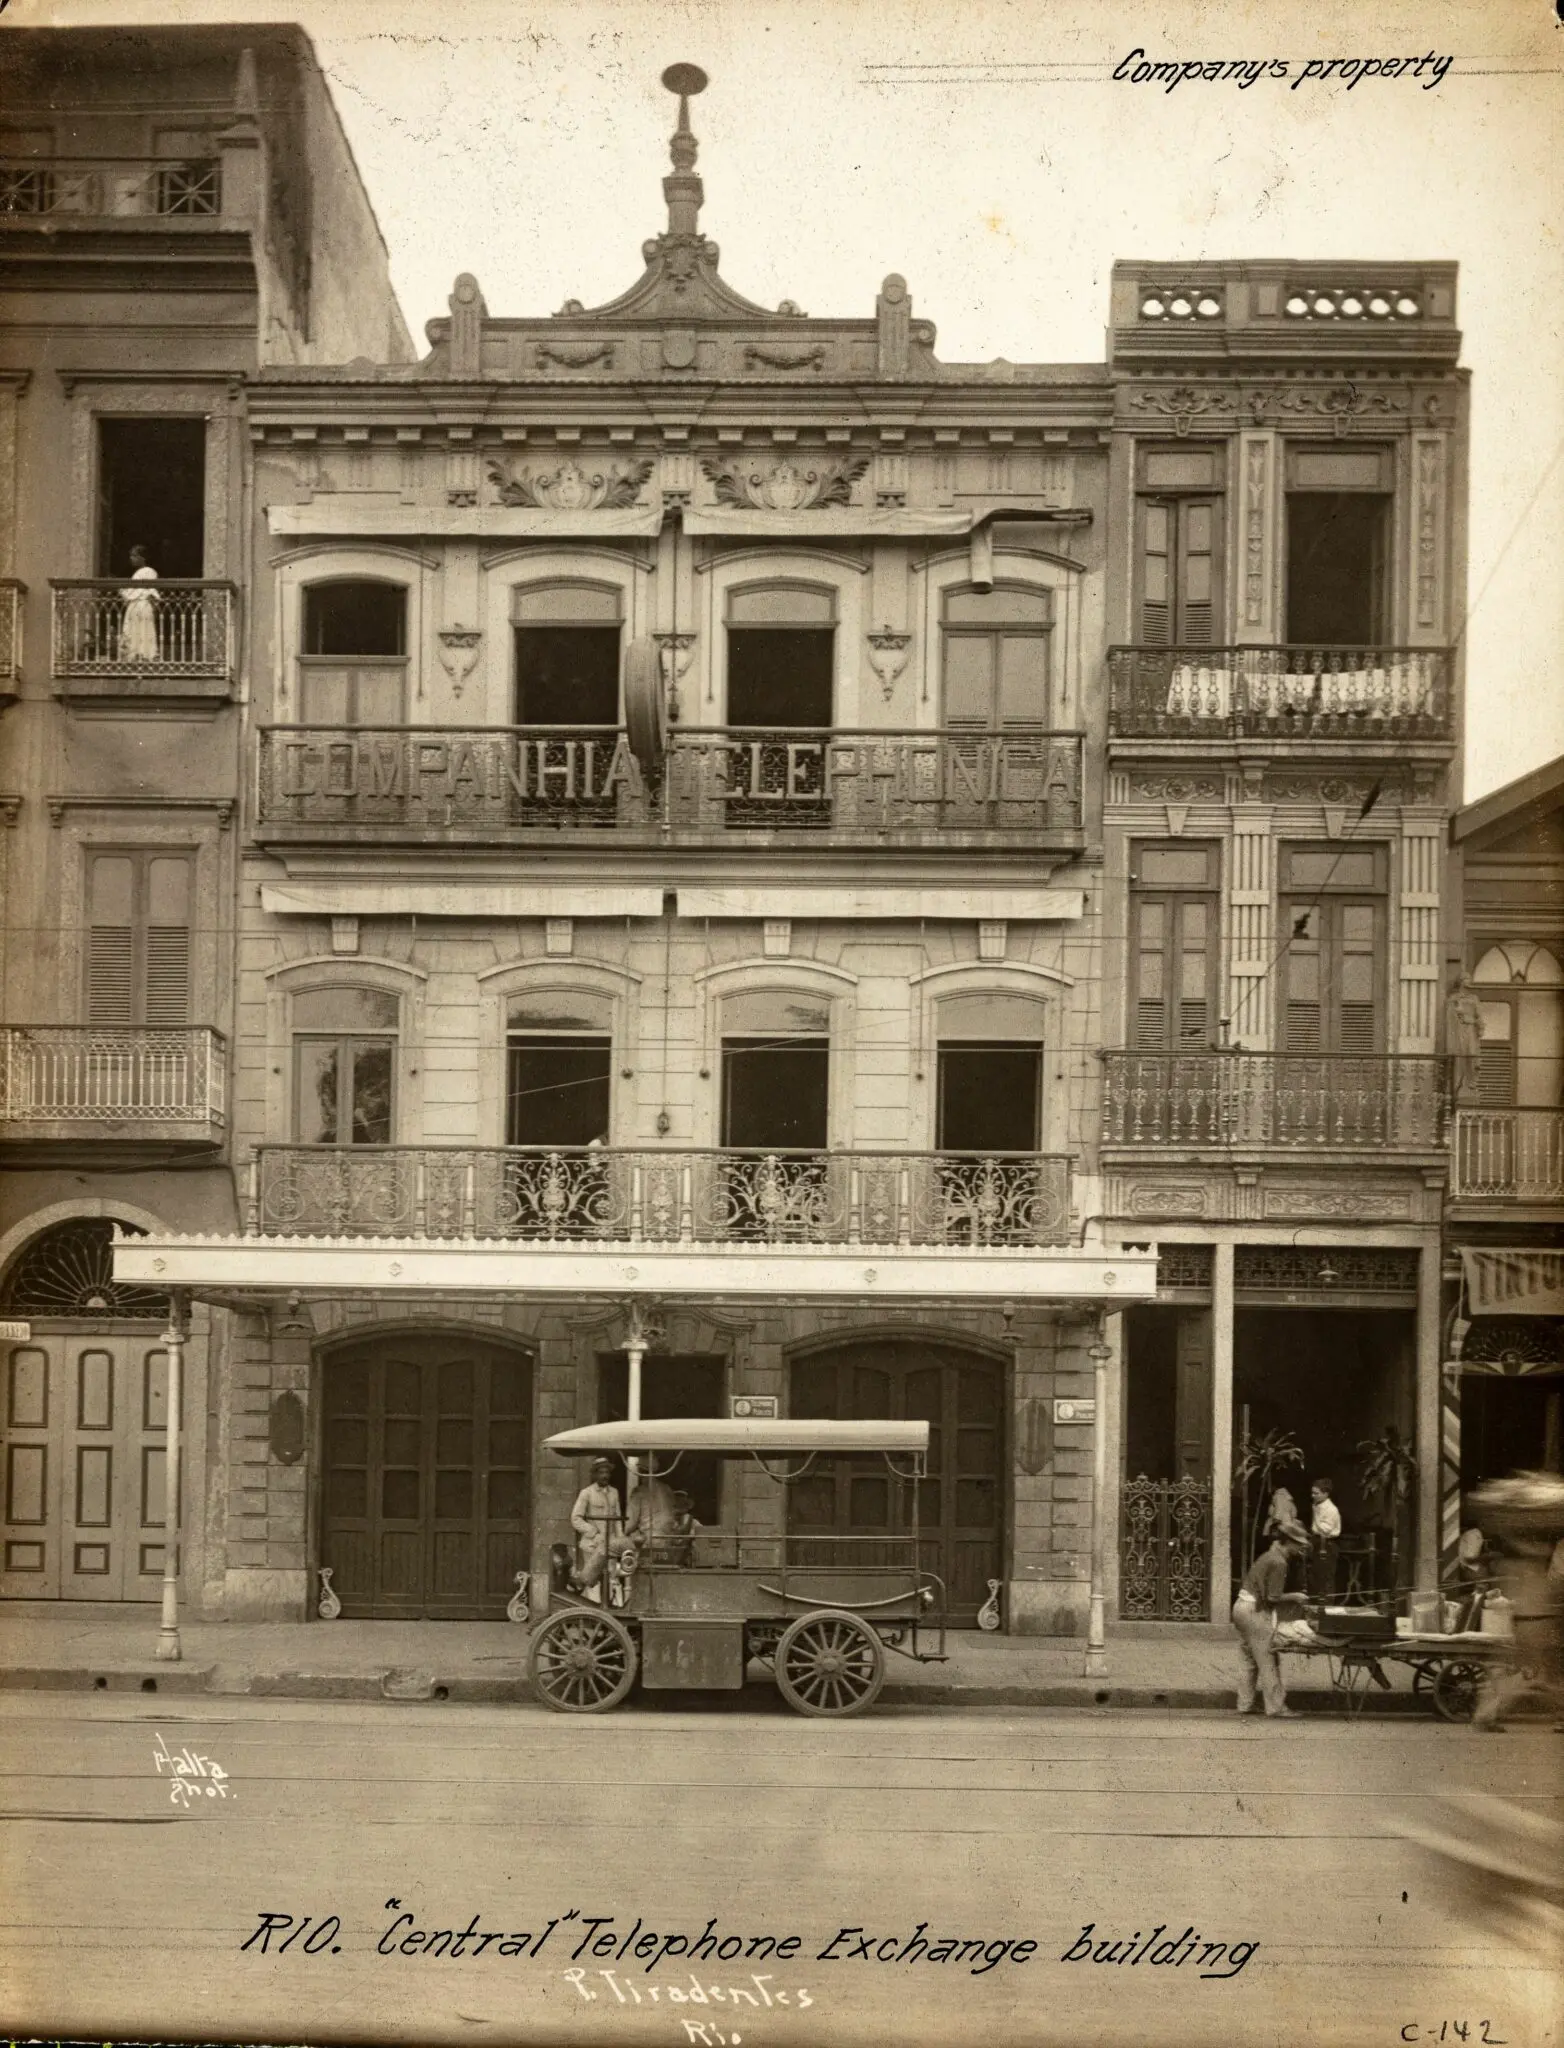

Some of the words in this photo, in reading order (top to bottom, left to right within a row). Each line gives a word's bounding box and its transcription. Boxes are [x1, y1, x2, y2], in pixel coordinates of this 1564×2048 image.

[280, 737, 646, 800] COMPANHIA
[669, 739, 1080, 804] TELEPHONICA
[1470, 1251, 1564, 1307] TINTU
